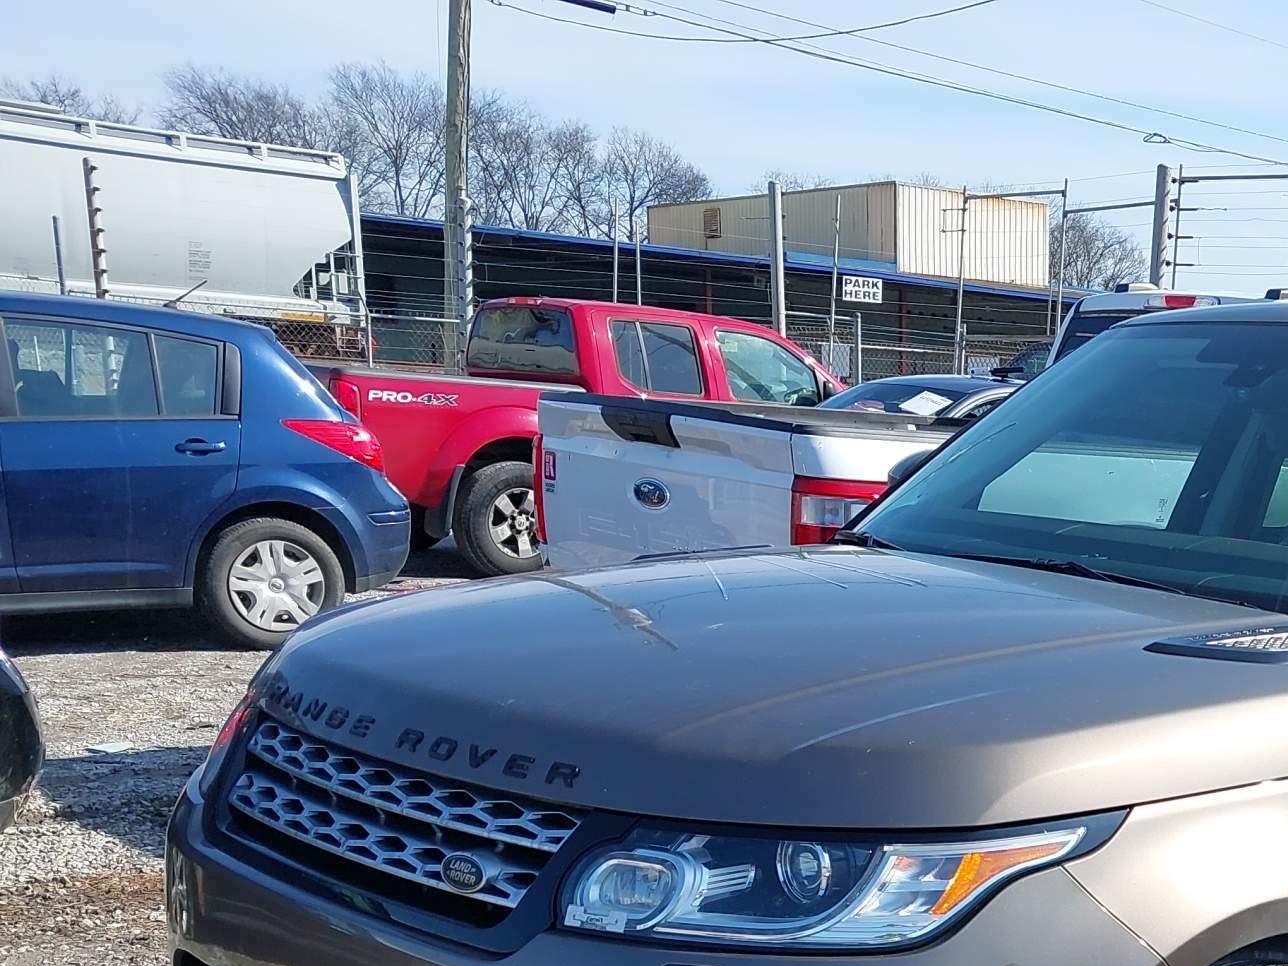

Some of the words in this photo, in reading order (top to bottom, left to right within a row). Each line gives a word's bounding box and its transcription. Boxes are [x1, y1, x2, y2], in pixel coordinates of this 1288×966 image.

[844, 278, 880, 290] PARK
[844, 289, 881, 301] HERE
[272, 683, 376, 739] RANGE
[396, 727, 582, 789] ROVER
[450, 859, 472, 873] LAND
[450, 870, 476, 886] ROVER
